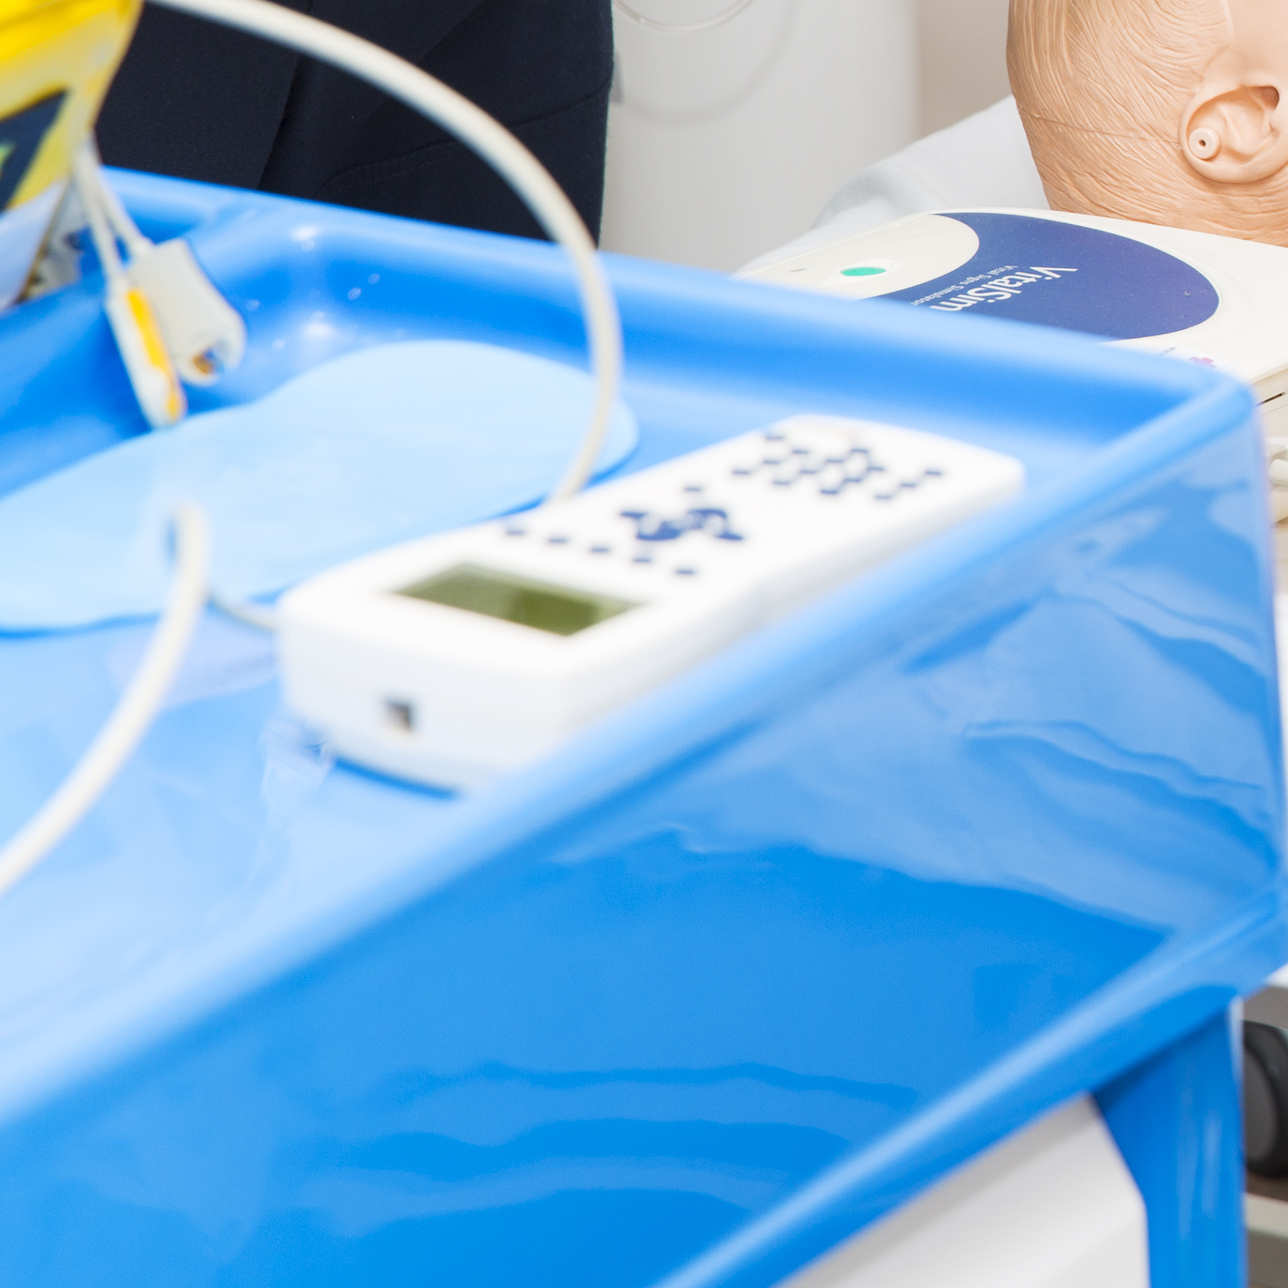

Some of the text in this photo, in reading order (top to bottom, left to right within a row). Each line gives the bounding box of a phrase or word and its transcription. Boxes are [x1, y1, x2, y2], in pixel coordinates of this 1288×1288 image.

[986, 265, 1018, 276] Vital
[959, 274, 992, 286] Signs
[930, 266, 1078, 311] VitalSim
